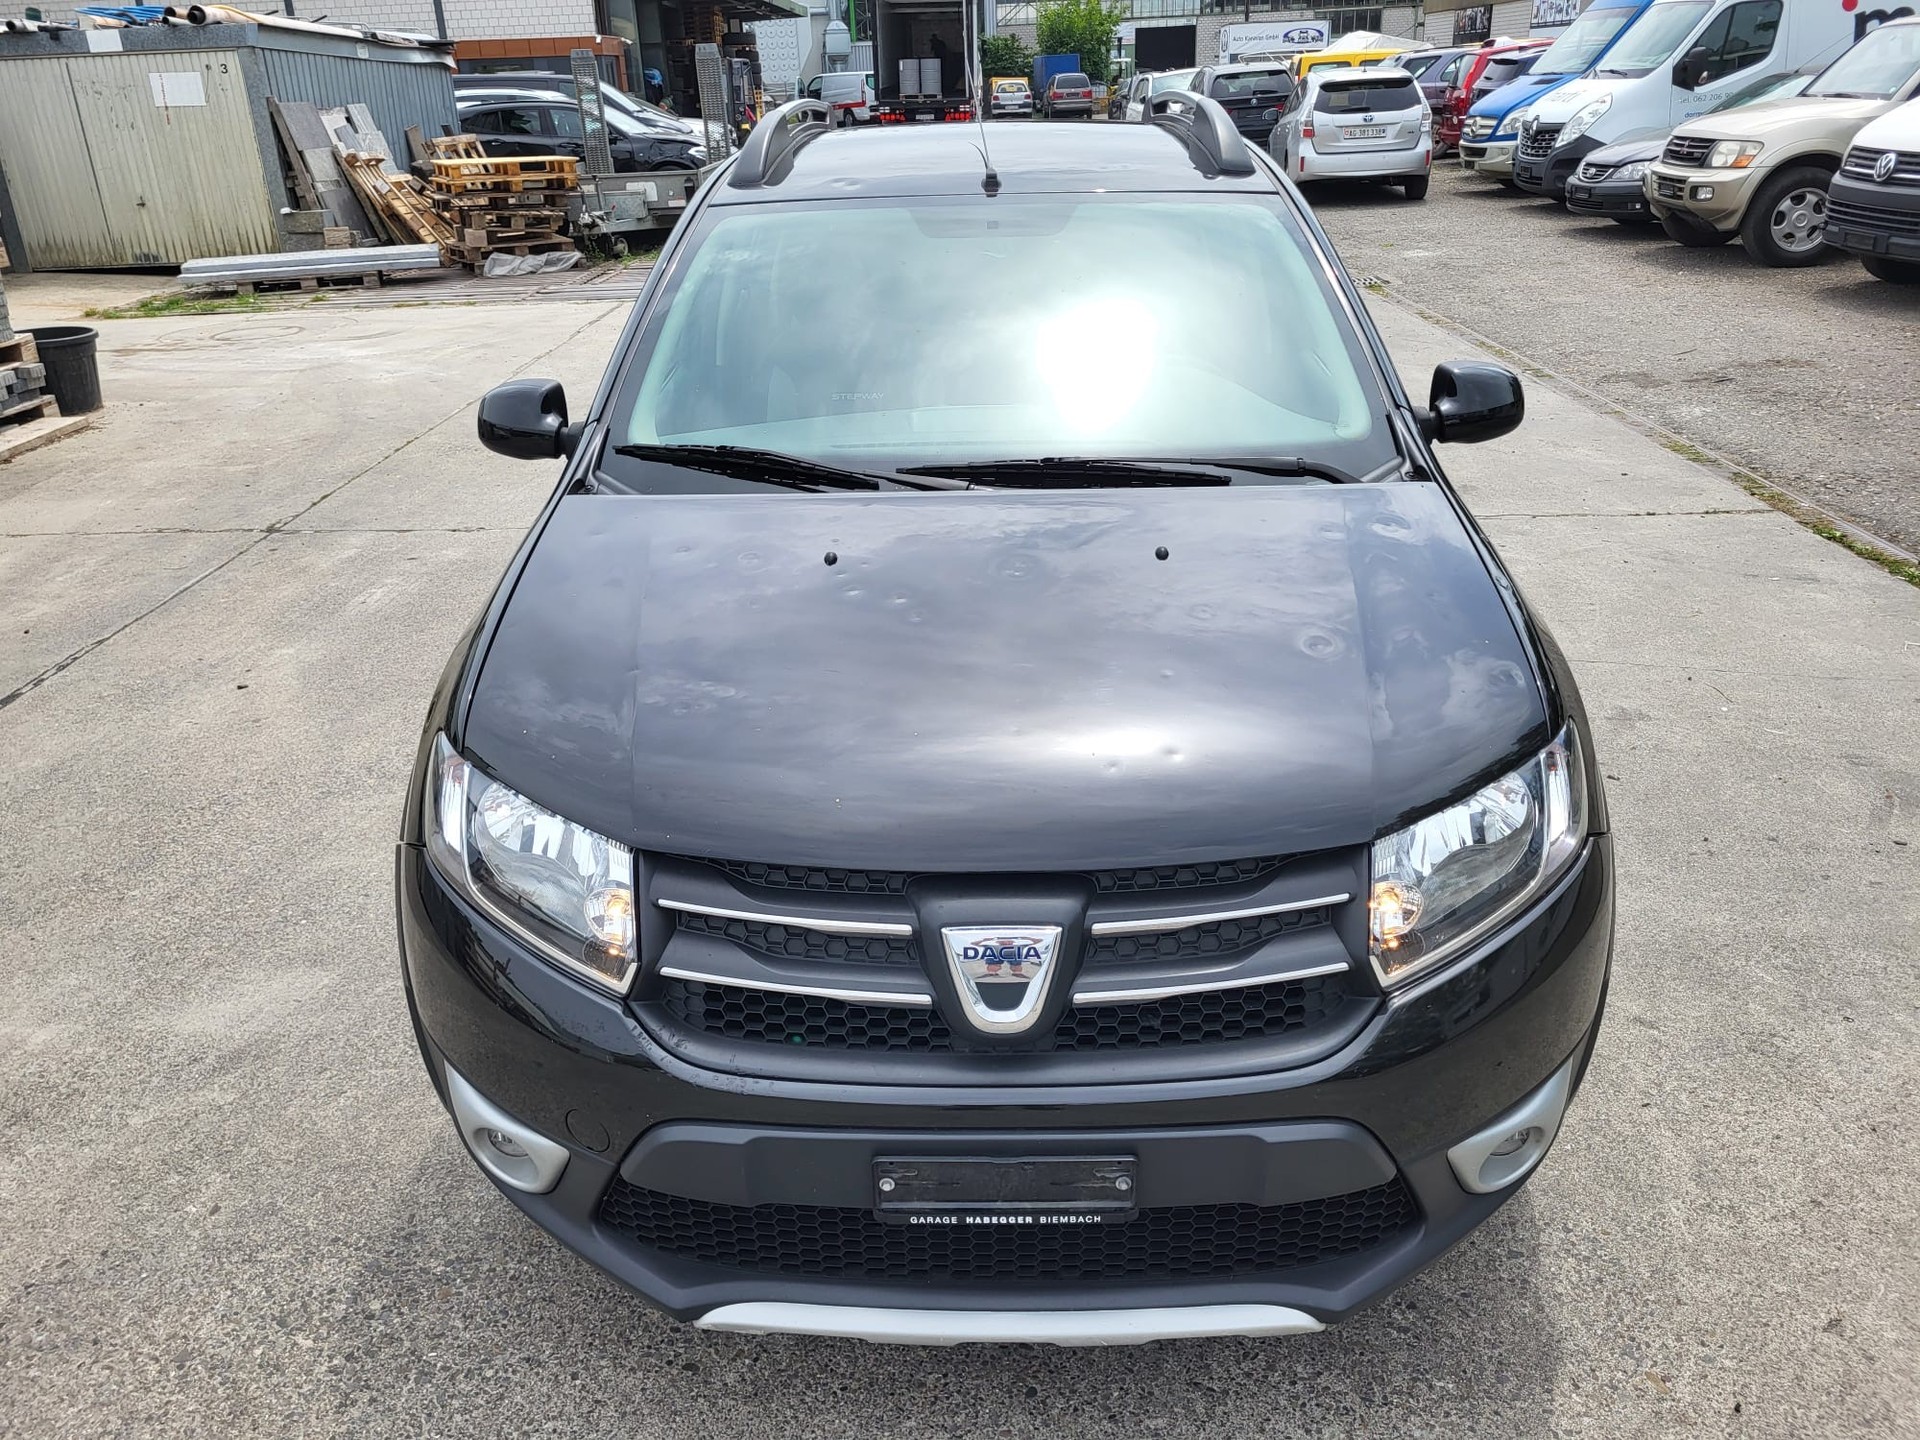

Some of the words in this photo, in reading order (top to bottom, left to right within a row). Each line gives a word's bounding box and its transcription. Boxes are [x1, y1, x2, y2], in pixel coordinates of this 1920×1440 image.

[1265, 33, 1280, 41] GmbH
[220, 63, 228, 74] 3
[1693, 95, 1707, 103] 062
[1708, 93, 1723, 101] 206
[831, 392, 884, 401] STEPWAY
[962, 946, 1042, 960] DACIA
[910, 1216, 958, 1224] GARAGE
[966, 1216, 1033, 1224] HABEGGER
[1039, 1215, 1101, 1224] BIEMBACH
